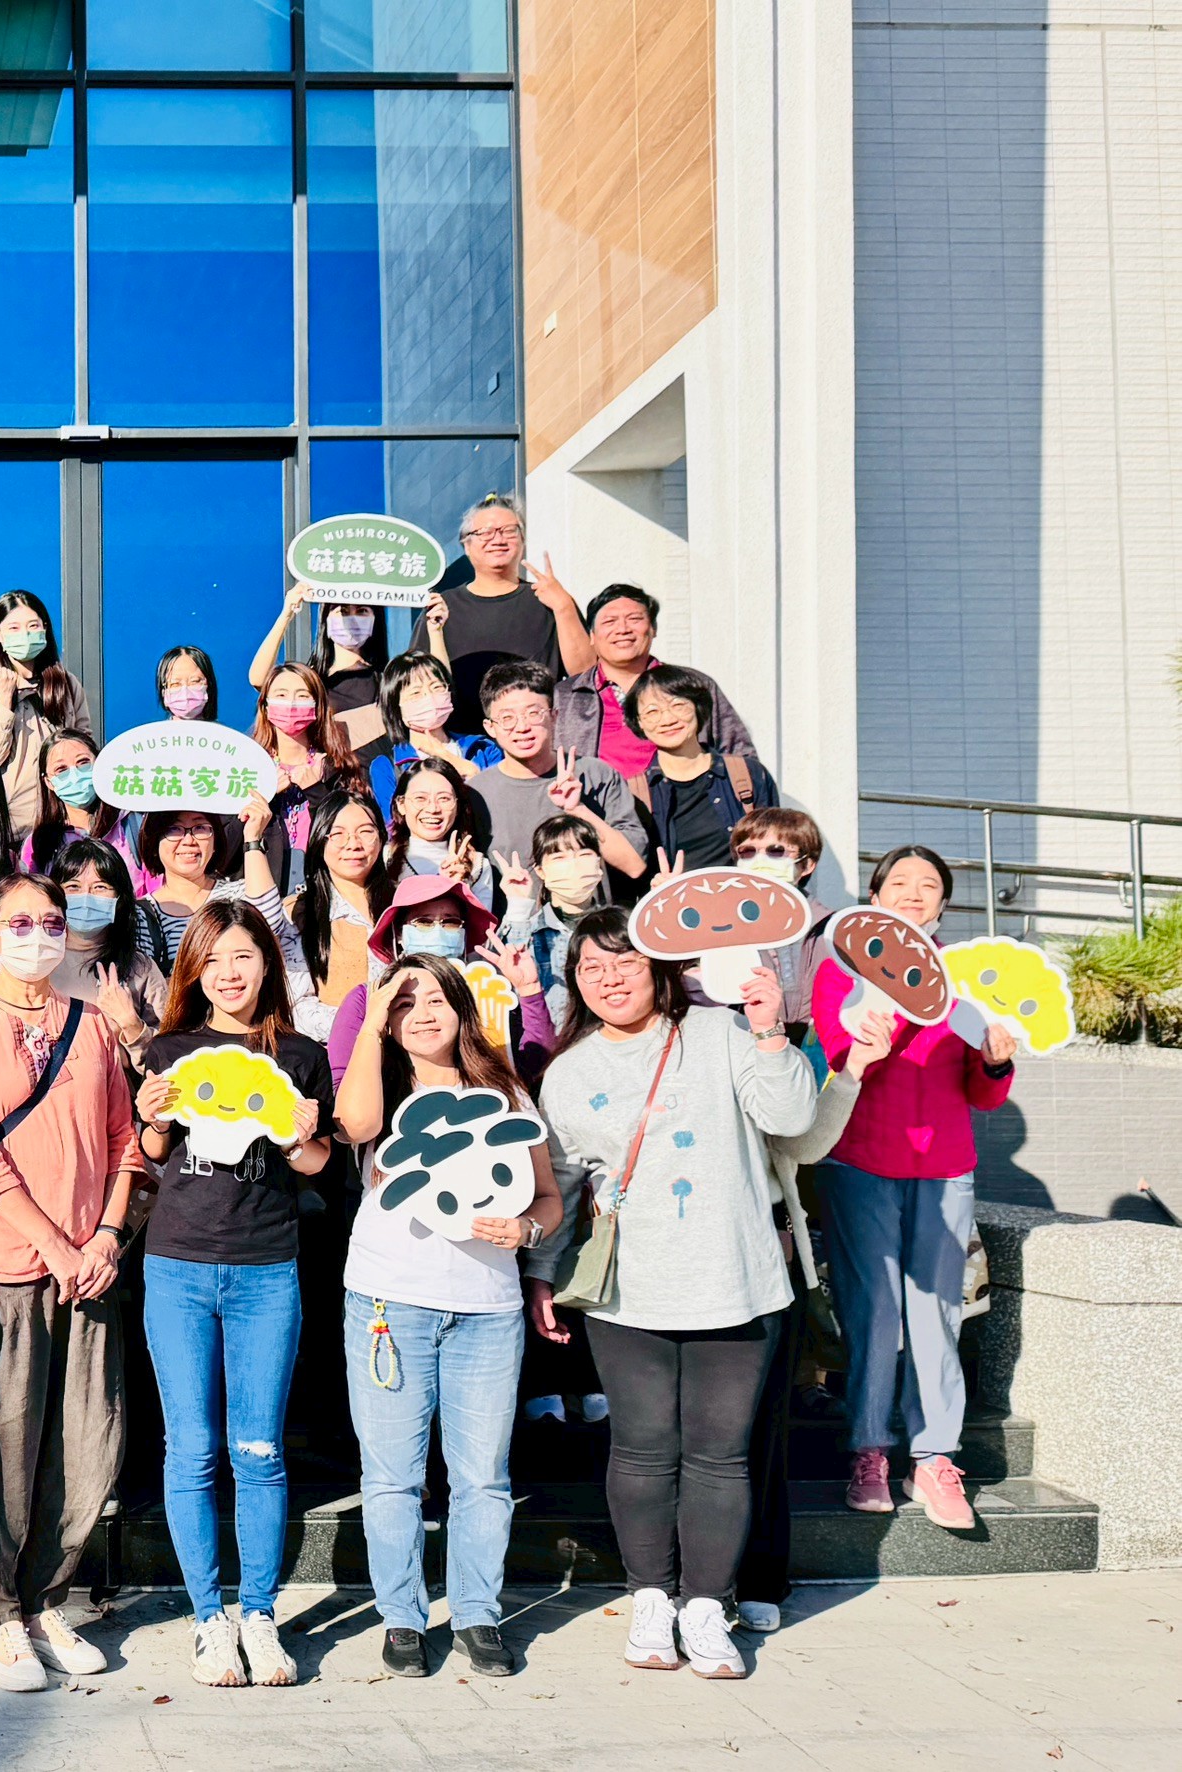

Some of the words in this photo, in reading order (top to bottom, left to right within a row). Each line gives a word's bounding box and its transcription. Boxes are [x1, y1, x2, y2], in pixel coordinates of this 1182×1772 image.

[323, 528, 410, 546] MUSHROOM
[307, 547, 427, 578] 菇菇家族
[341, 589, 372, 600] GOO
[376, 591, 426, 603] FAMILY
[132, 735, 237, 756] MUSHROOM
[112, 764, 259, 798] 菇菇家族
